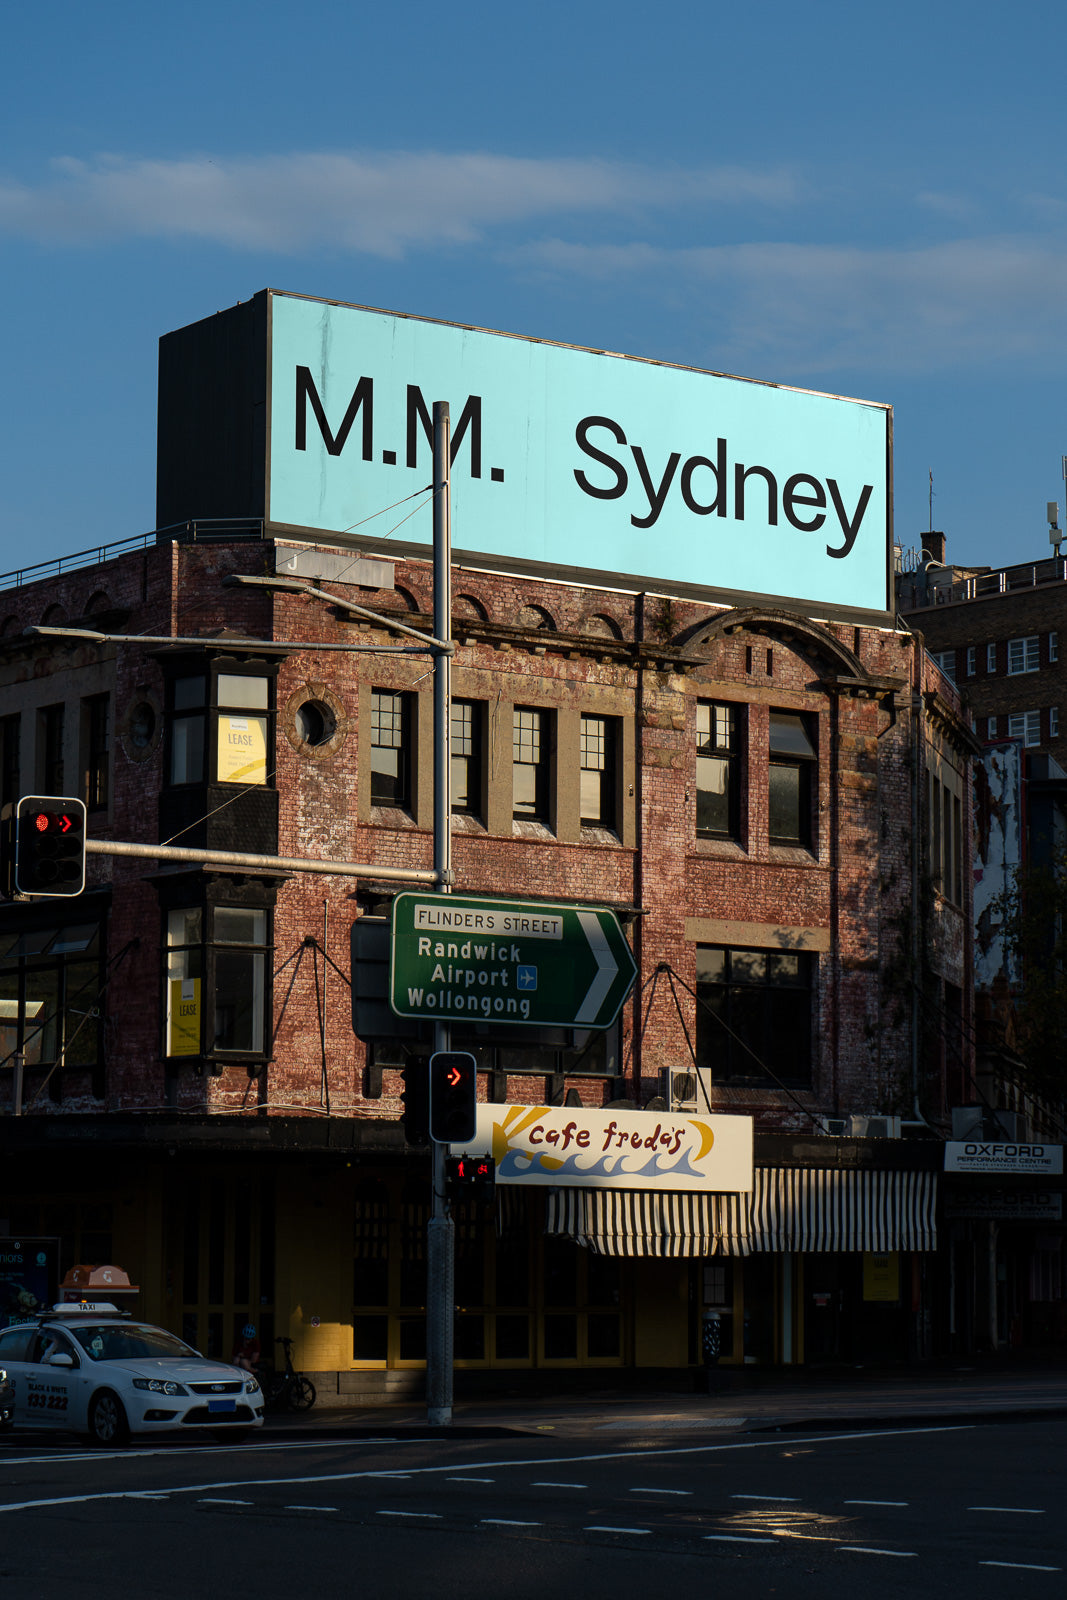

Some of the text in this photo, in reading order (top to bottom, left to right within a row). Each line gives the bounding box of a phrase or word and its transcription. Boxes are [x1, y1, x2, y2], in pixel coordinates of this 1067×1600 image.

[295, 365, 875, 559] M.M. Sydney
[287, 553, 298, 571] J
[228, 733, 253, 746] LEASE
[418, 910, 559, 934] FLINDERS STREET
[418, 937, 521, 963] Randwick
[431, 963, 509, 988] Airport
[180, 1004, 196, 1016] LEASE
[407, 987, 530, 1019] Wollongong
[528, 1121, 686, 1155] cafe freda's
[965, 1144, 1044, 1156] OXFORD
[28, 1393, 68, 1410] 133 222
